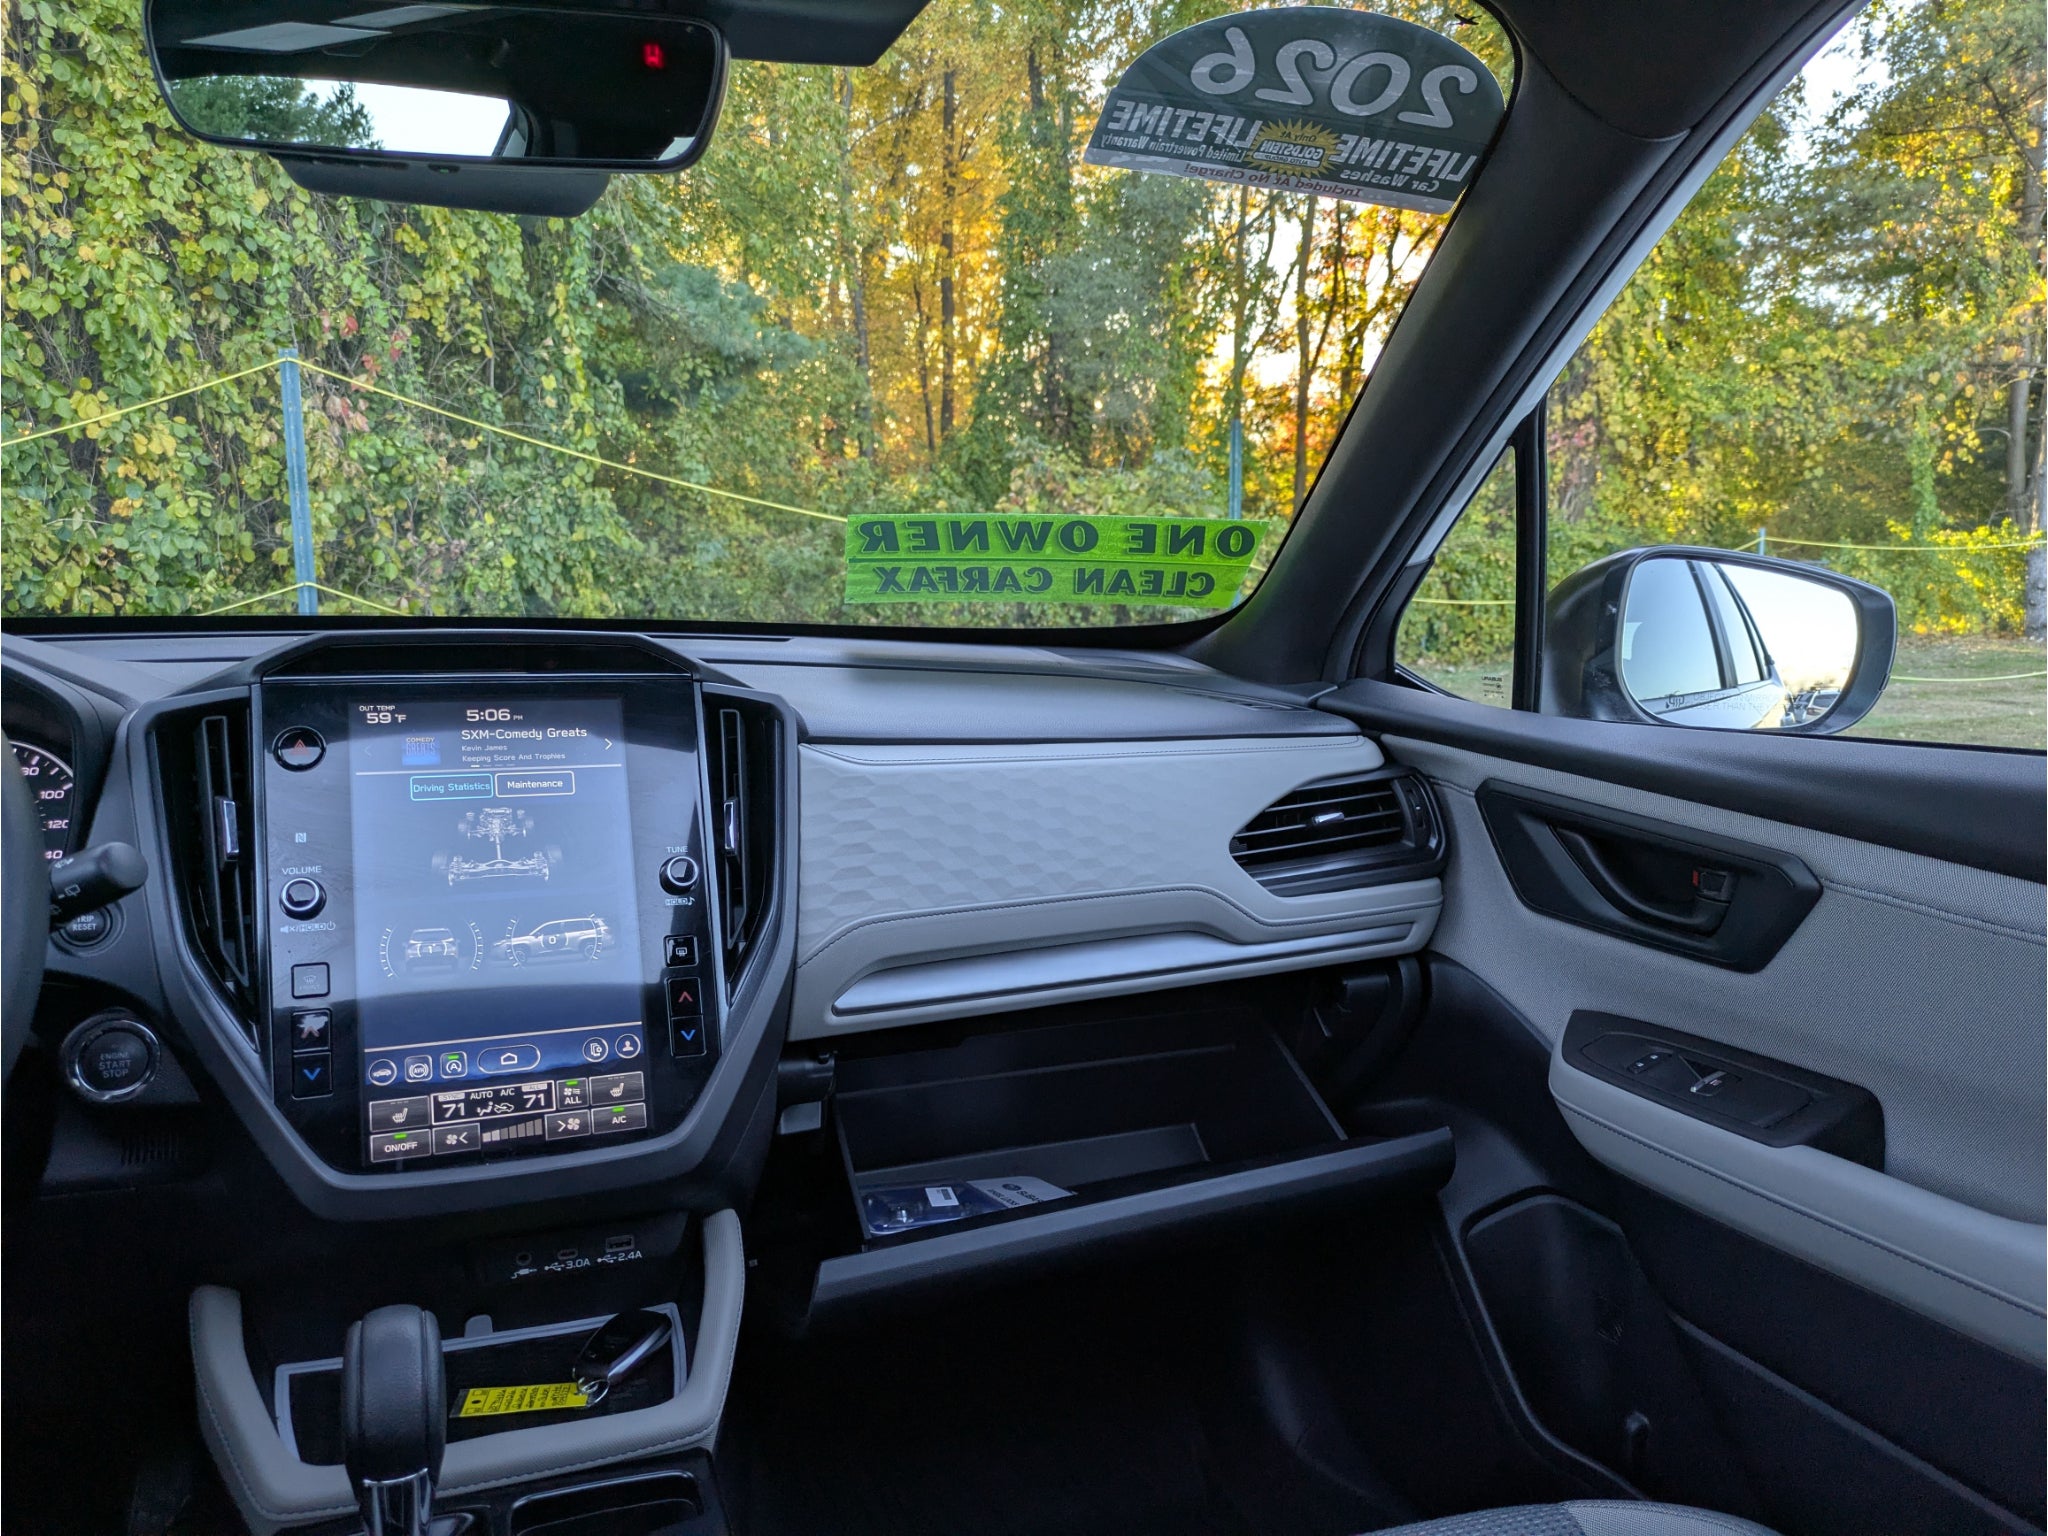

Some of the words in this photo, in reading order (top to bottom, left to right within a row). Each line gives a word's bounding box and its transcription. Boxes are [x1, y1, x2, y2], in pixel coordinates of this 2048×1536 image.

[366, 712, 392, 724] 59
[466, 708, 511, 722] 5:06
[461, 728, 542, 740] SXM-Comedy
[547, 727, 587, 738] Greats
[462, 755, 491, 763] Keeping
[535, 753, 566, 761] Trophies
[413, 784, 445, 794] Driving
[448, 782, 491, 791] Statistics
[507, 780, 563, 789] Maintenance
[40, 790, 65, 800] 100
[666, 845, 689, 853] TUNE
[281, 865, 322, 875] VOLUME
[72, 922, 97, 931] RESET
[100, 1051, 132, 1060] ENGINE
[99, 1060, 132, 1070] START
[103, 1069, 129, 1079] STOP
[470, 1090, 494, 1100] AUTO
[500, 1088, 515, 1097] A/C
[523, 1093, 545, 1108] 71
[564, 1096, 582, 1105] ALL
[442, 1102, 465, 1118] 71
[611, 1115, 627, 1124] A/C
[384, 1141, 418, 1153] ON/OFF
[618, 1250, 643, 1261] 2.4A
[565, 1258, 591, 1269] 3.0A
